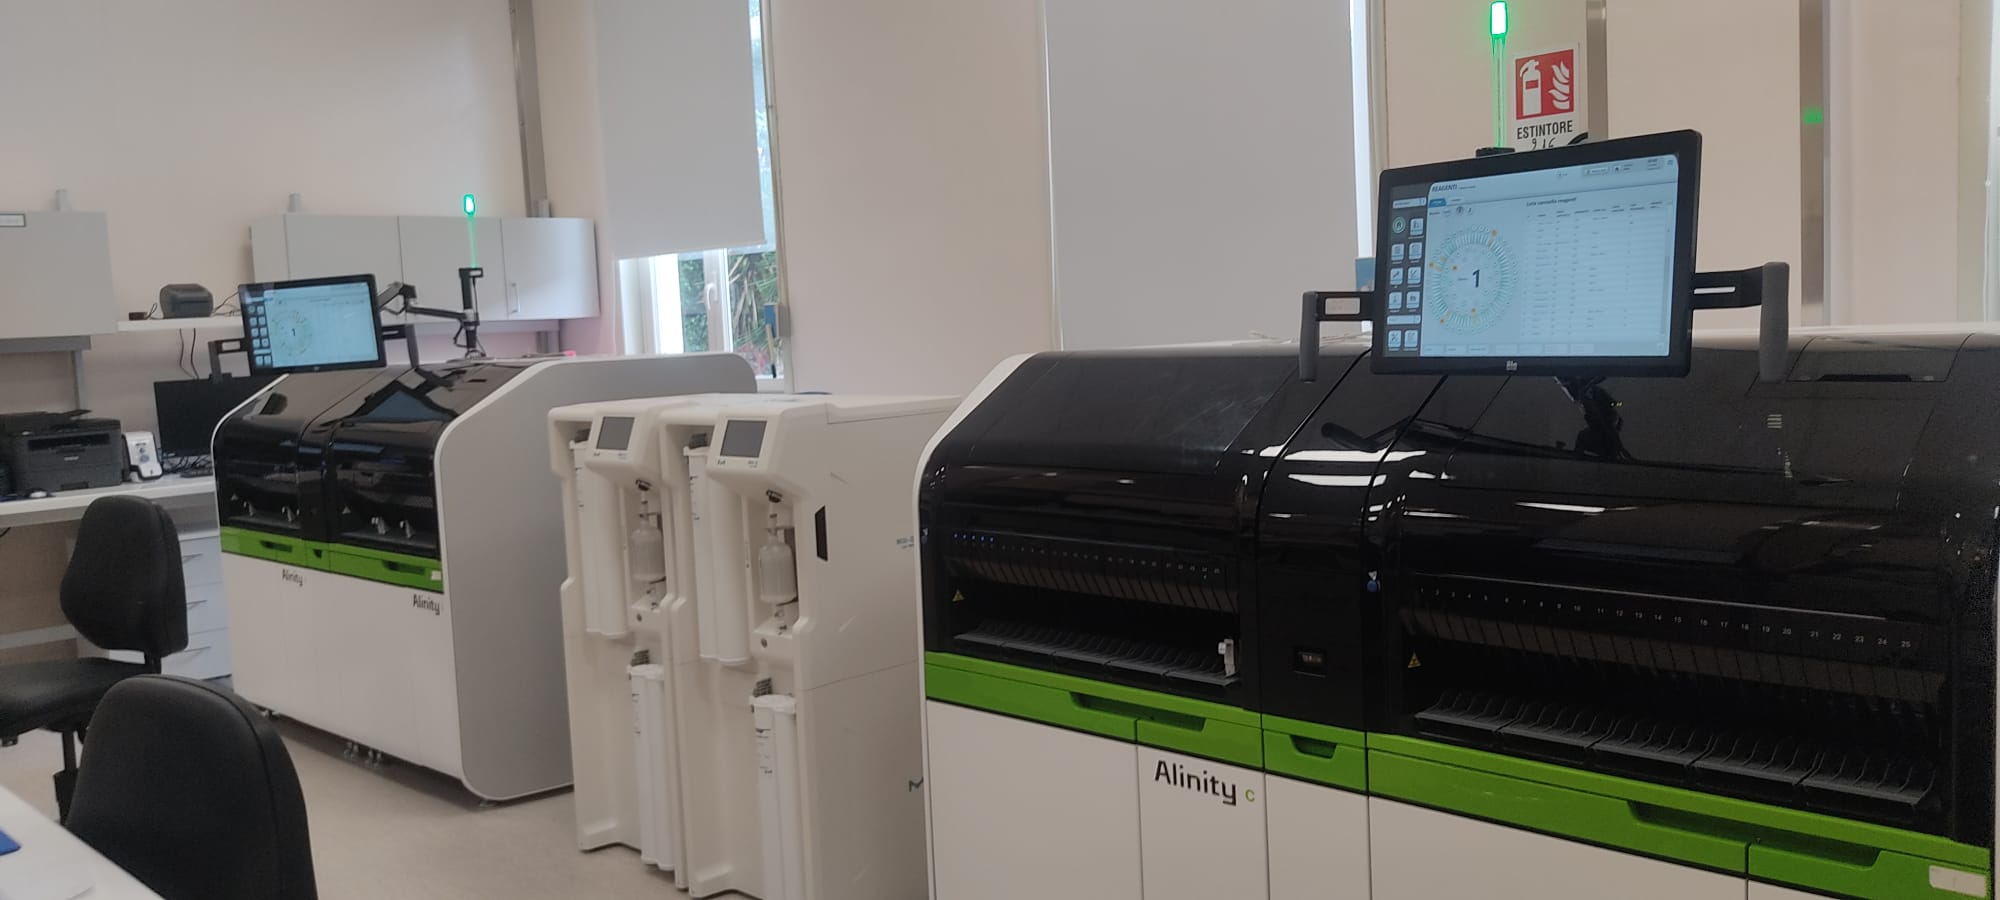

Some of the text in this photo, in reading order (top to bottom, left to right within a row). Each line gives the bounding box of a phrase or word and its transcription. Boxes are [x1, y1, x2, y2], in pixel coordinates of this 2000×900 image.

[1516, 119, 1574, 140] ESTINTORE
[1472, 269, 1480, 288] 1
[281, 568, 303, 587] Alinity
[412, 593, 441, 616] Alinity
[1782, 627, 1792, 635] 20
[1809, 630, 1819, 638] 21
[1832, 632, 1842, 641] 22
[1854, 635, 1865, 644] 23
[1877, 637, 1888, 646] 24
[1901, 640, 1911, 648] 25
[1154, 759, 1237, 807] Alinity
